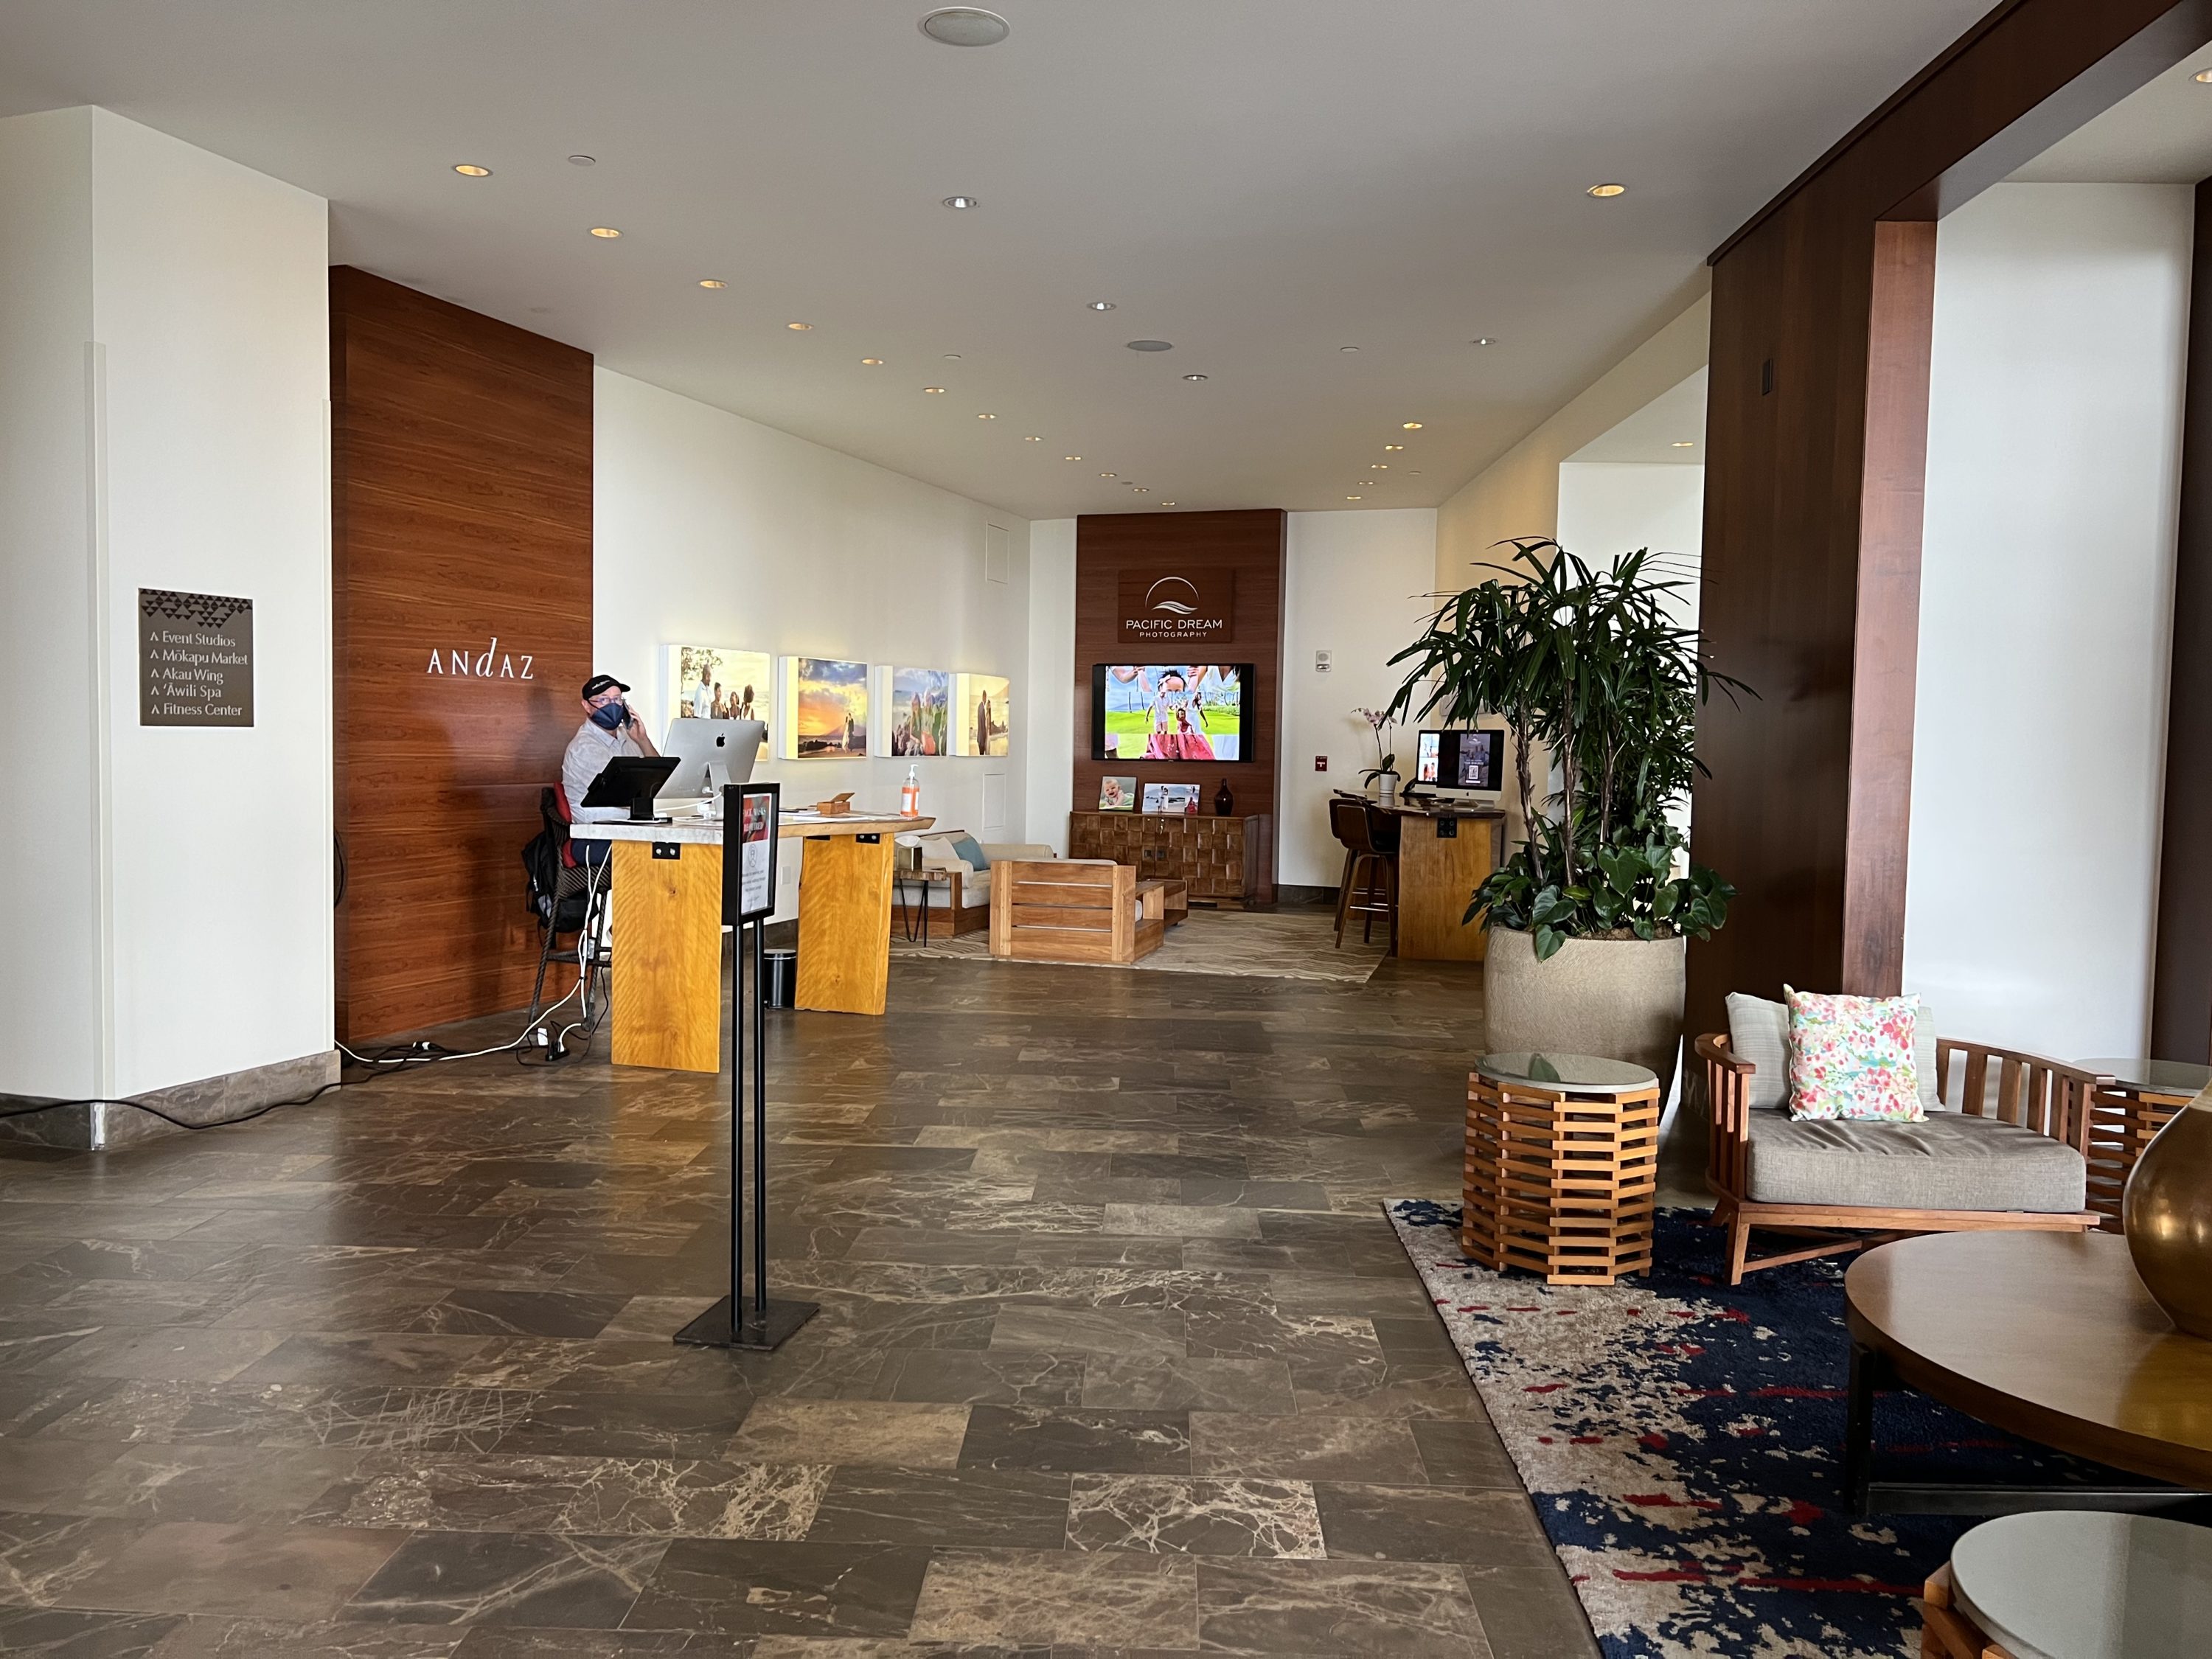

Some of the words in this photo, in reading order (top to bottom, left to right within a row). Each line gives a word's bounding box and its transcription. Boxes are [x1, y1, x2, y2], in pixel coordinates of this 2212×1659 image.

[1126, 619, 1172, 630] PACIFIC
[1178, 619, 1222, 629] DREAM
[162, 630, 192, 644] Event
[195, 633, 236, 647] Studios
[211, 651, 248, 665] Market
[162, 667, 192, 681] Akau
[193, 668, 224, 685] Wing
[200, 685, 222, 701] Spa
[163, 703, 203, 715] Fitness
[204, 703, 243, 716] Center
